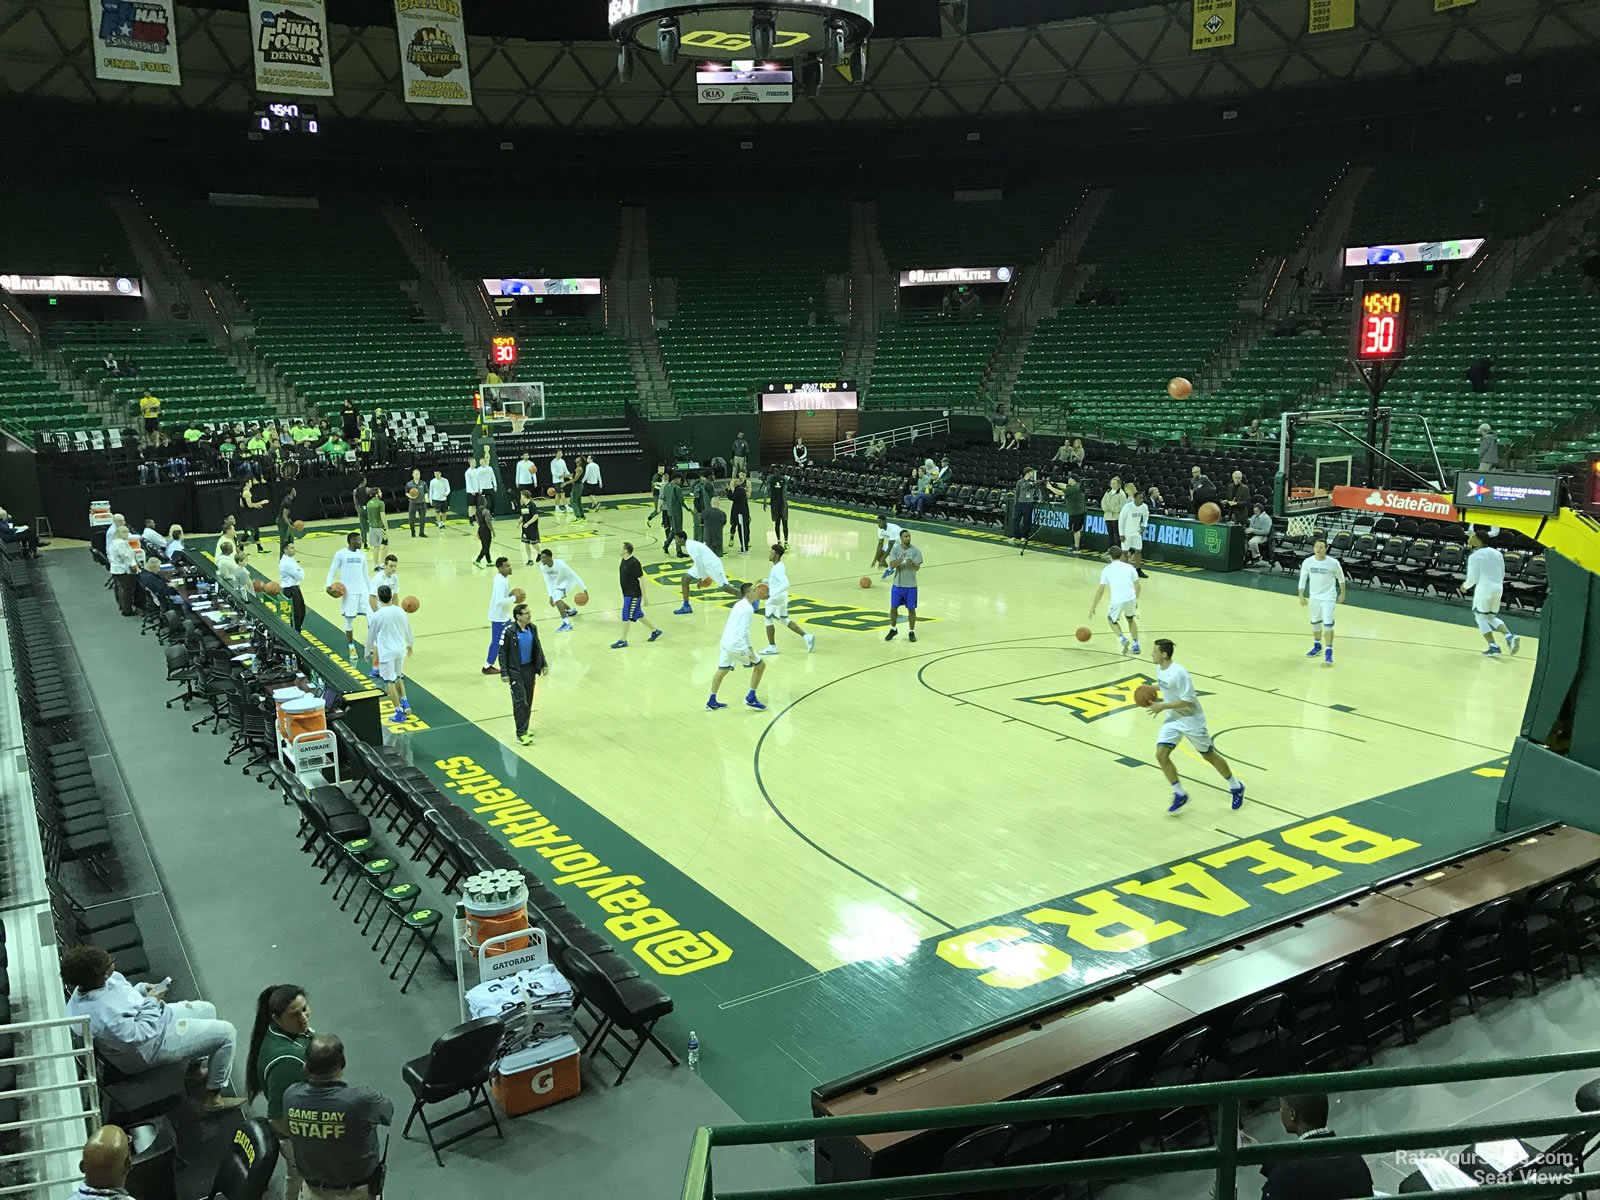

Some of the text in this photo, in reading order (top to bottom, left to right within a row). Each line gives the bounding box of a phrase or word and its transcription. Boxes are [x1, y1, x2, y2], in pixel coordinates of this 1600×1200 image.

[276, 17, 319, 37] FINAL
[261, 26, 320, 56] FOUR
[103, 57, 172, 73] FINAL FOUR
[271, 51, 316, 64] DENVER
[705, 91, 722, 99] KIA
[260, 117, 271, 131] 0
[308, 120, 319, 133] 0
[1364, 293, 1401, 315] 45:47
[492, 336, 515, 346] 45:47
[1366, 316, 1395, 353] 30
[496, 346, 513, 361] 30
[768, 383, 775, 392] 0
[842, 381, 849, 390] 0
[783, 401, 836, 410] BASKETBALL
[1158, 526, 1194, 549] ARENA
[300, 744, 331, 753] GATORADE
[434, 755, 733, 976] @BaylorAthletics
[935, 815, 1422, 990] BEARS
[492, 954, 536, 972] GATORADE
[530, 1066, 555, 1095] G
[288, 1107, 346, 1123] GAME DAY
[288, 1122, 346, 1143] STAFF
[233, 1129, 257, 1168] BAYLOR
